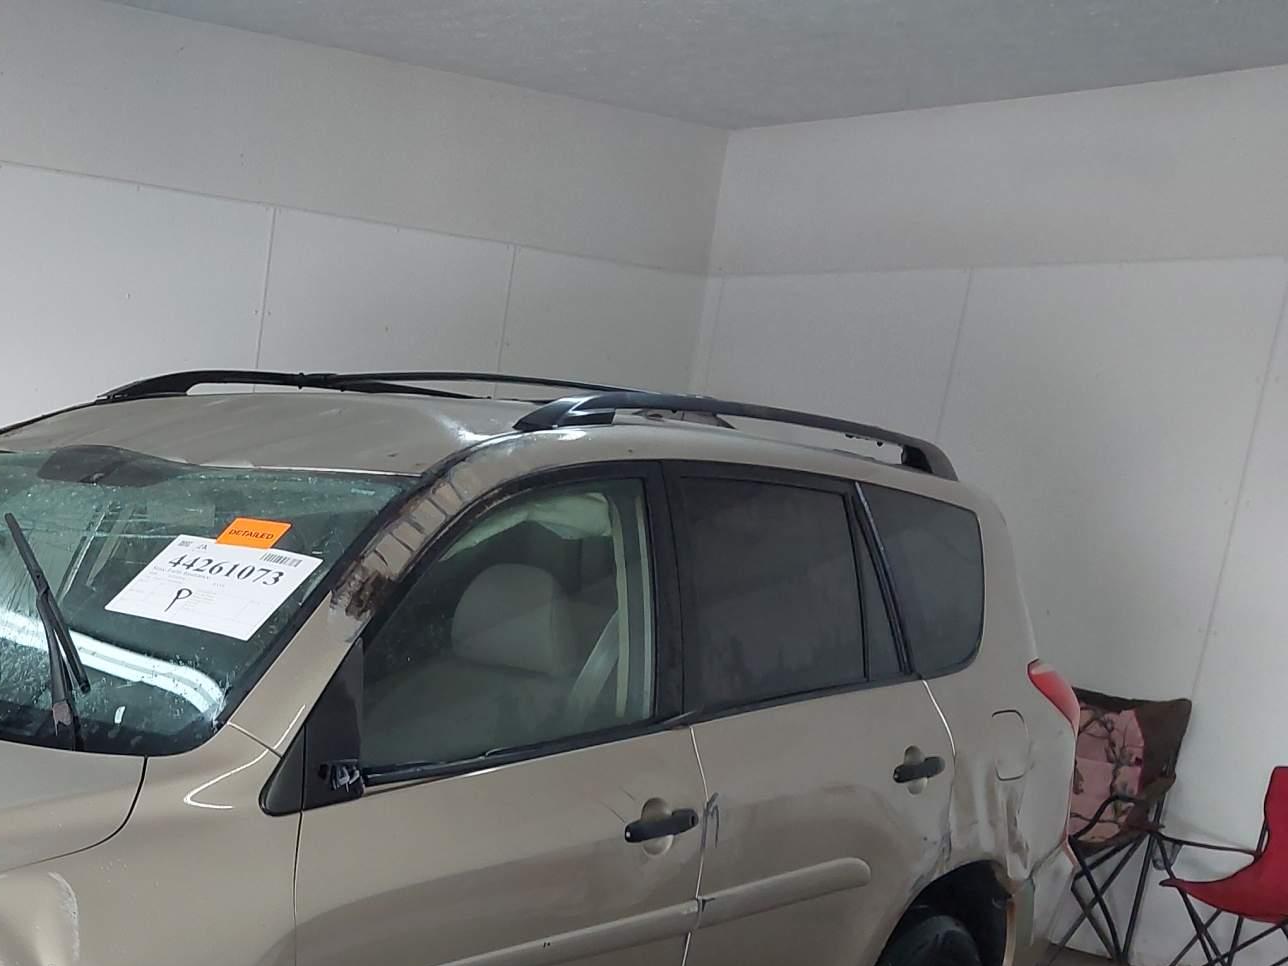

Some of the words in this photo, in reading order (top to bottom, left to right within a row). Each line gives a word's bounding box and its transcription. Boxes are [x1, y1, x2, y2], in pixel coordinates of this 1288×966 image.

[228, 528, 274, 540] DETAILED
[168, 553, 284, 585] 44261073
[164, 587, 192, 612] P
